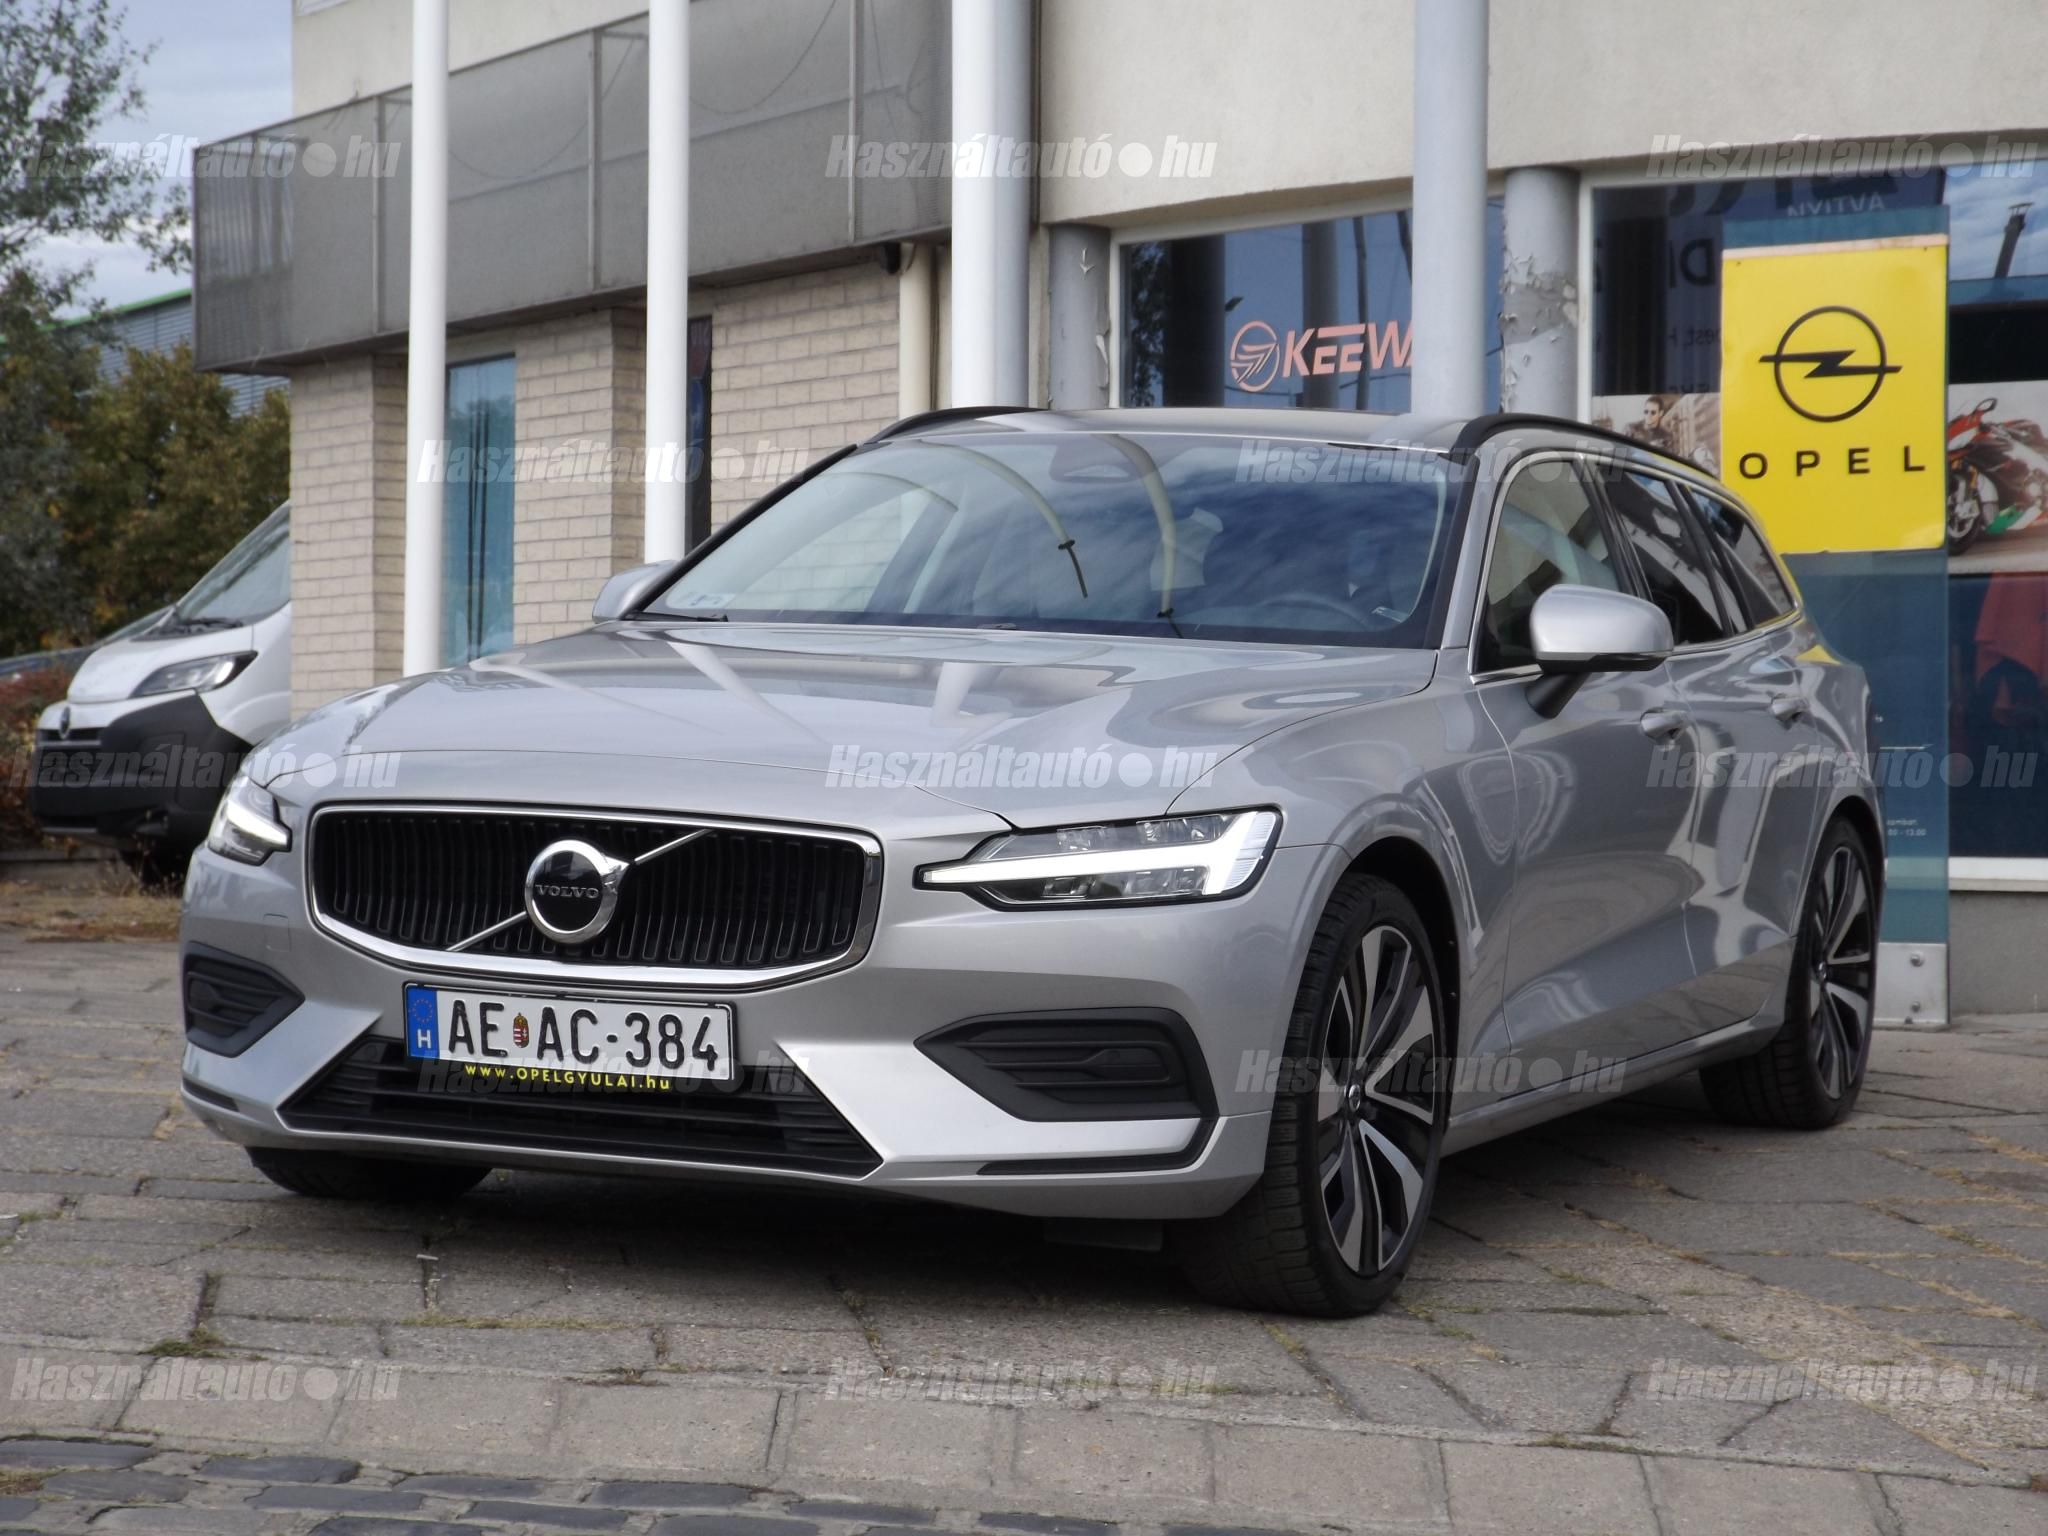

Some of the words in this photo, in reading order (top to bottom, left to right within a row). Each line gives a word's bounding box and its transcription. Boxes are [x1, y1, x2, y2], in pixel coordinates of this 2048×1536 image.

[1739, 445, 1925, 479] OPEL
[535, 884, 599, 899] VOLVO
[417, 1029, 432, 1049] H
[448, 1000, 508, 1058] AE
[537, 1006, 719, 1071] AC-384
[465, 1064, 670, 1090] www.OPELGYULAI.hu
